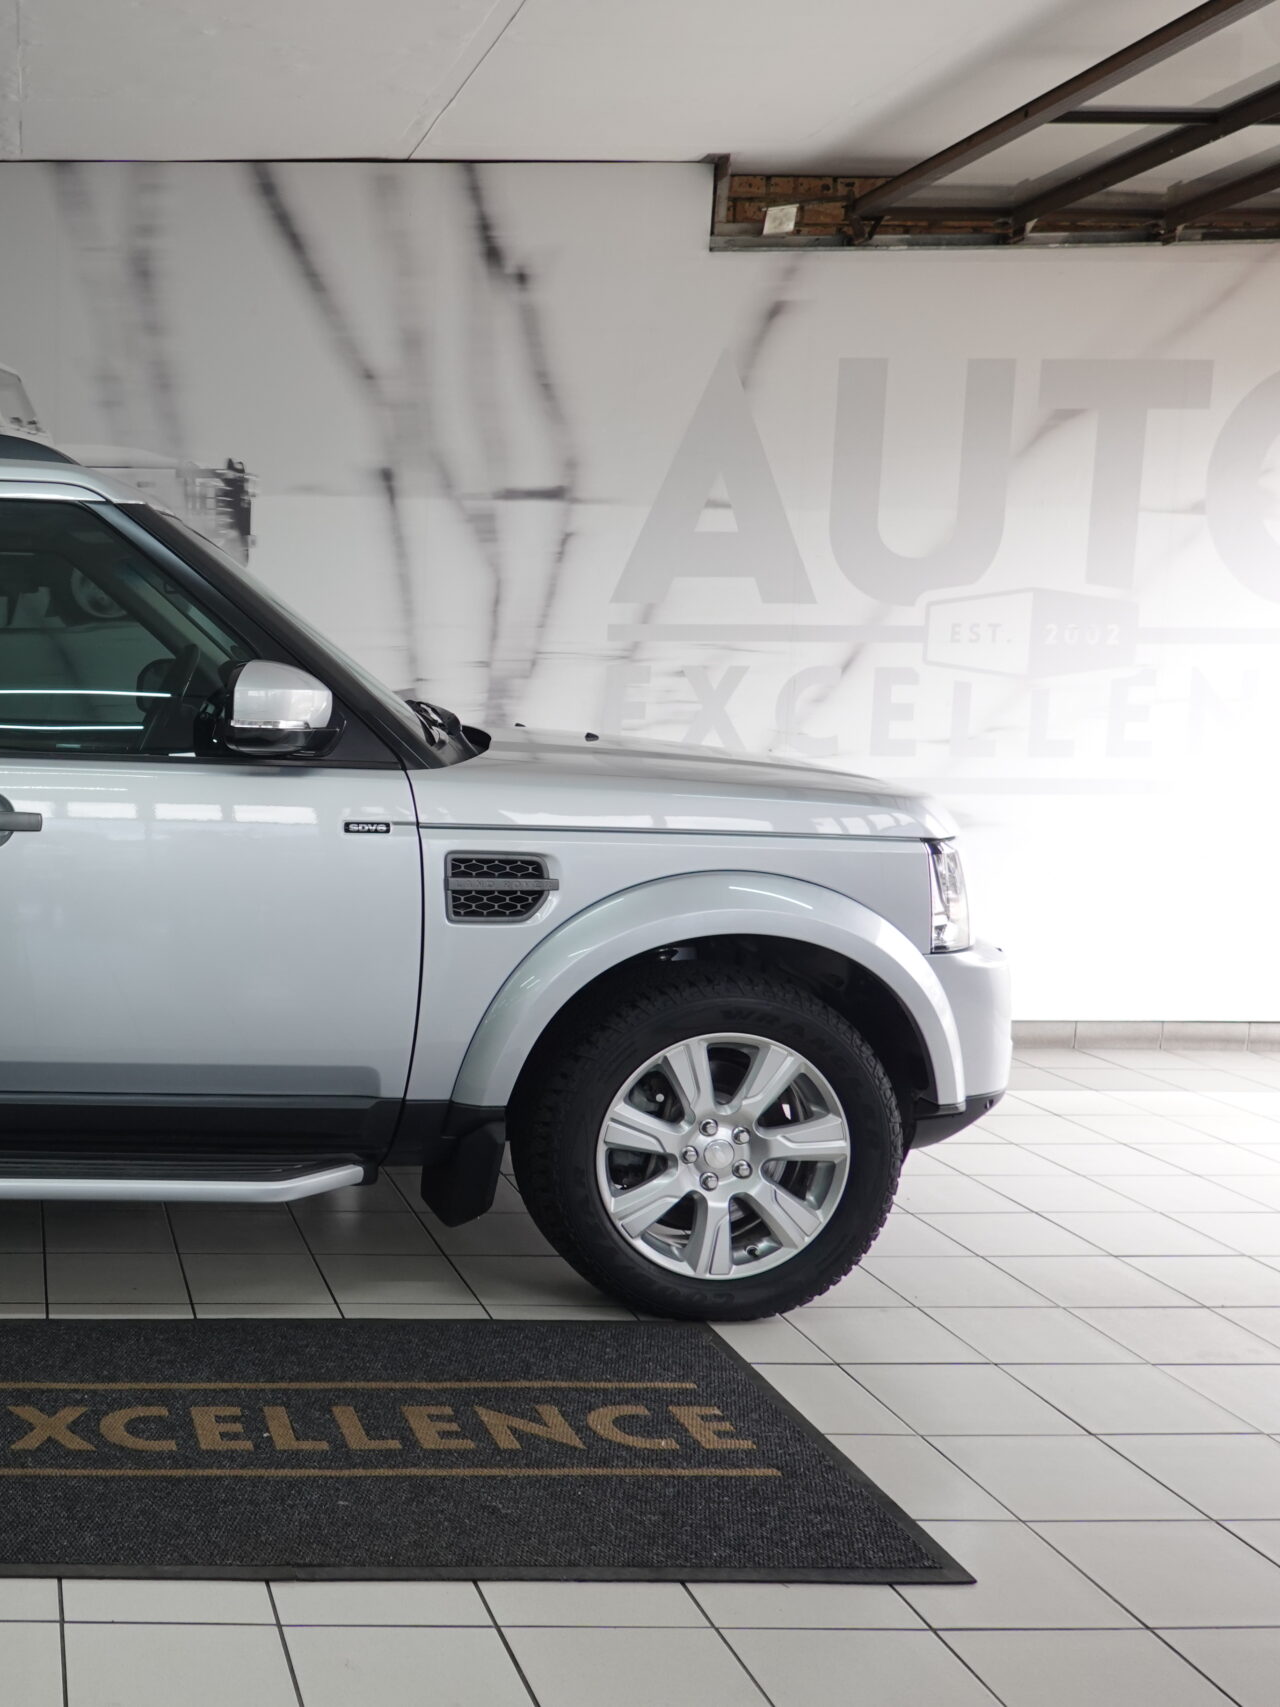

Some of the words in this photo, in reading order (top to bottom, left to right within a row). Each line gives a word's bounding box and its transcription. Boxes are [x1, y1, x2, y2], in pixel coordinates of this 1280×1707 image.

[950, 623, 1011, 644] EST.
[1044, 623, 1121, 646] 2002
[348, 823, 387, 832] SDV6
